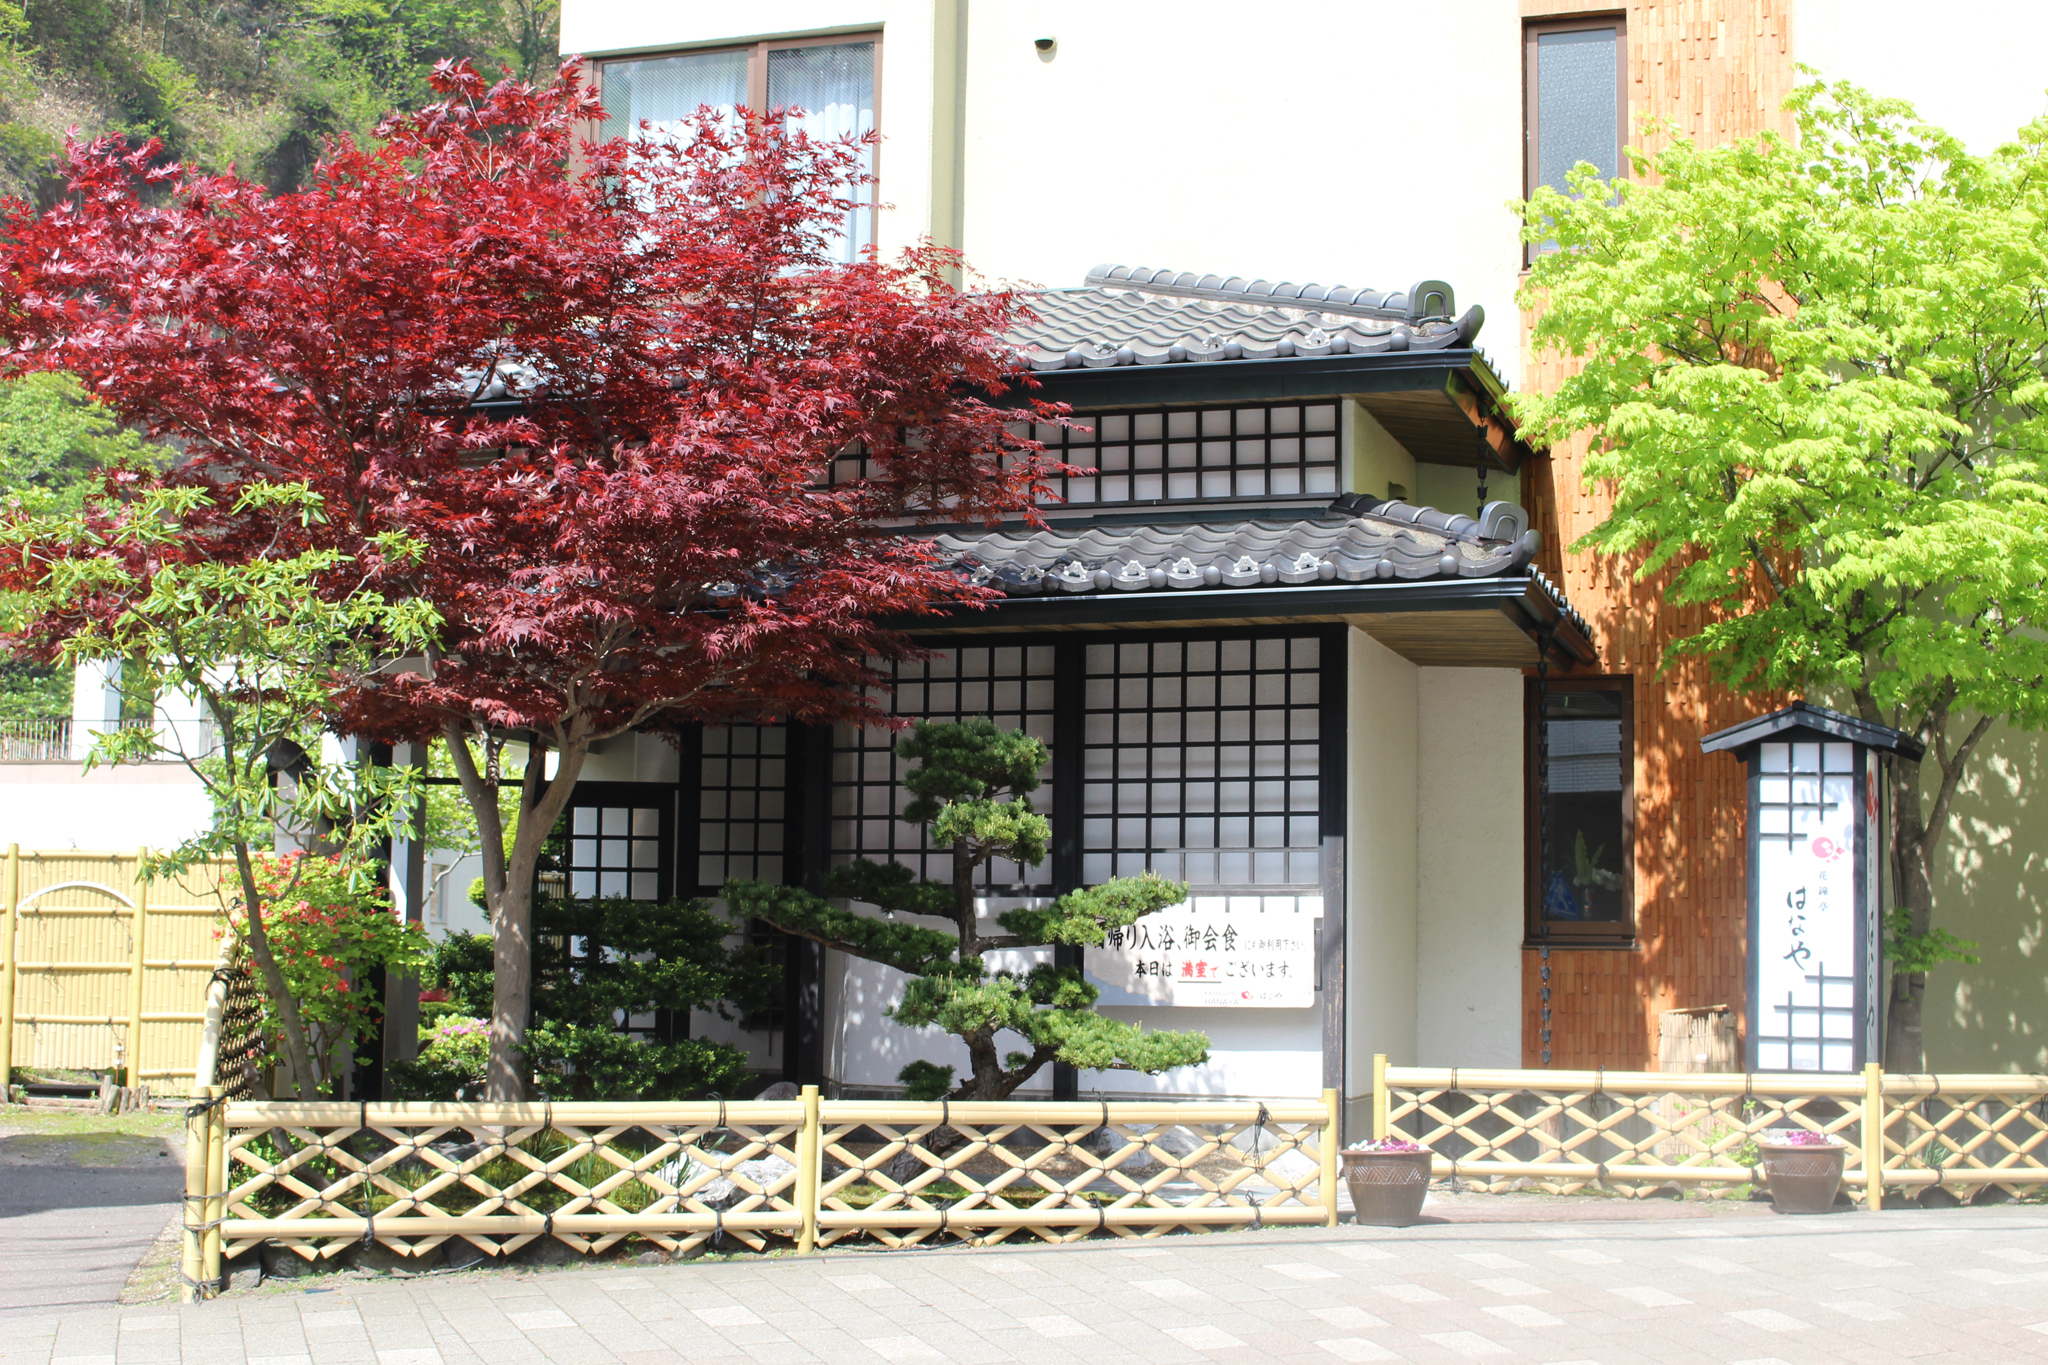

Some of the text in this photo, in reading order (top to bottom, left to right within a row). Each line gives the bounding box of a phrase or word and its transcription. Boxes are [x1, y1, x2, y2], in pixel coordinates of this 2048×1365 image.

[1783, 886, 1811, 971] はなや
[1135, 959, 1173, 978] 本日は
[1226, 960, 1292, 979] ございます。
[1204, 998, 1239, 1006] HANAYA
